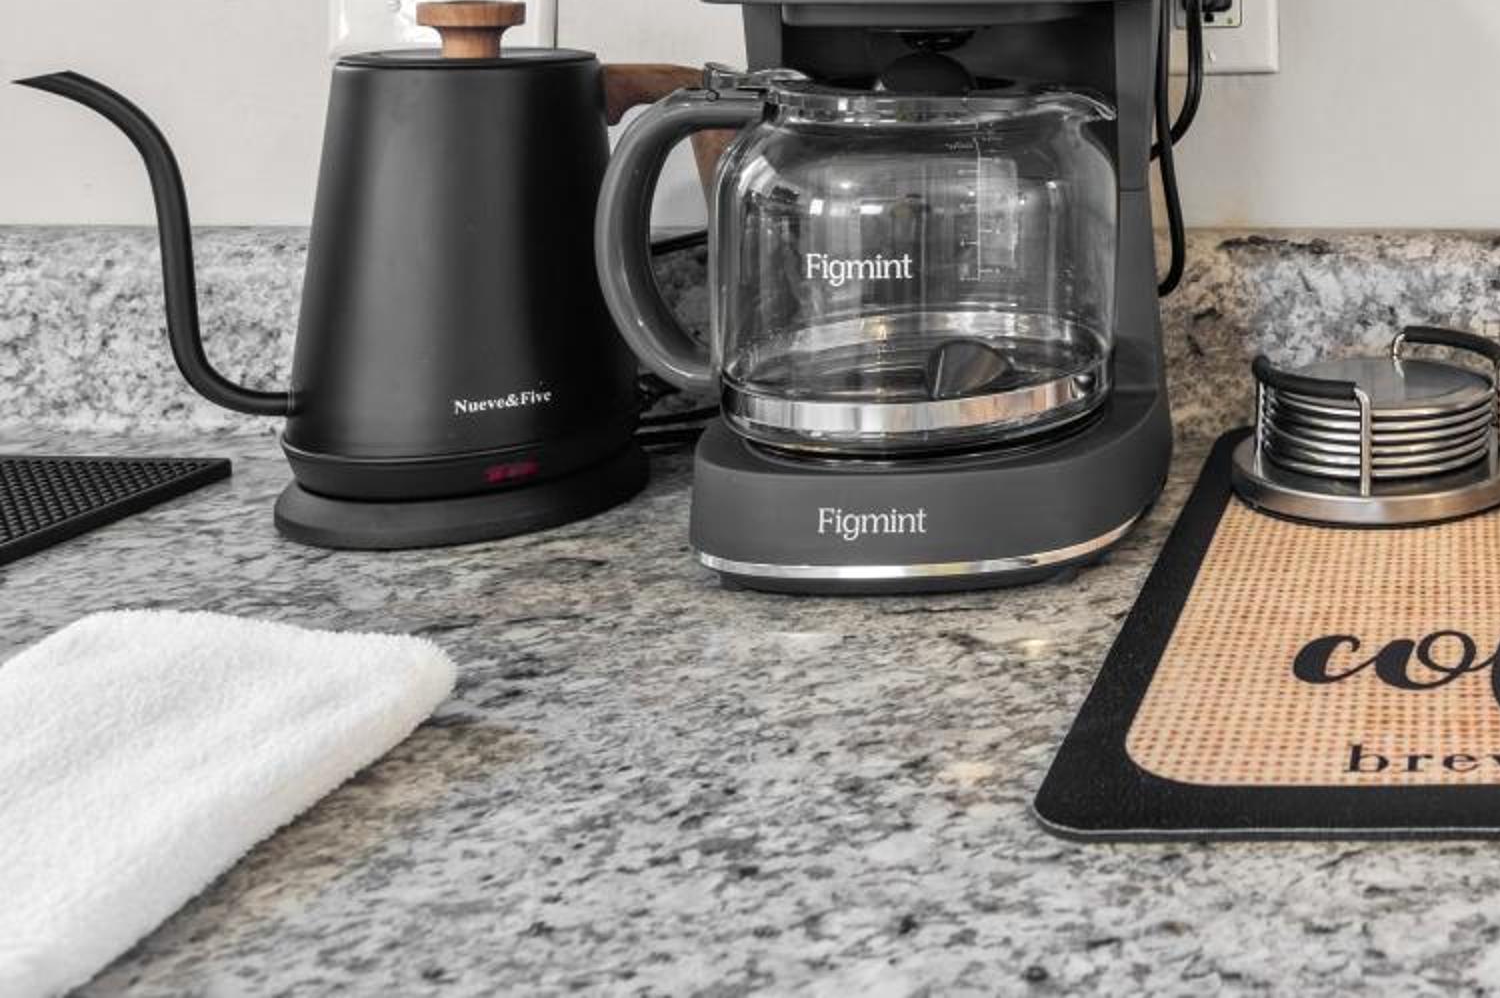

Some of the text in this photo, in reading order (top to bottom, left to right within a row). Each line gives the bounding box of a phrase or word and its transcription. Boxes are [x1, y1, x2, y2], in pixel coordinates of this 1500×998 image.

[805, 253, 913, 287] Figmint
[453, 389, 553, 415] Nueve&Five
[817, 508, 927, 540] Figmint
